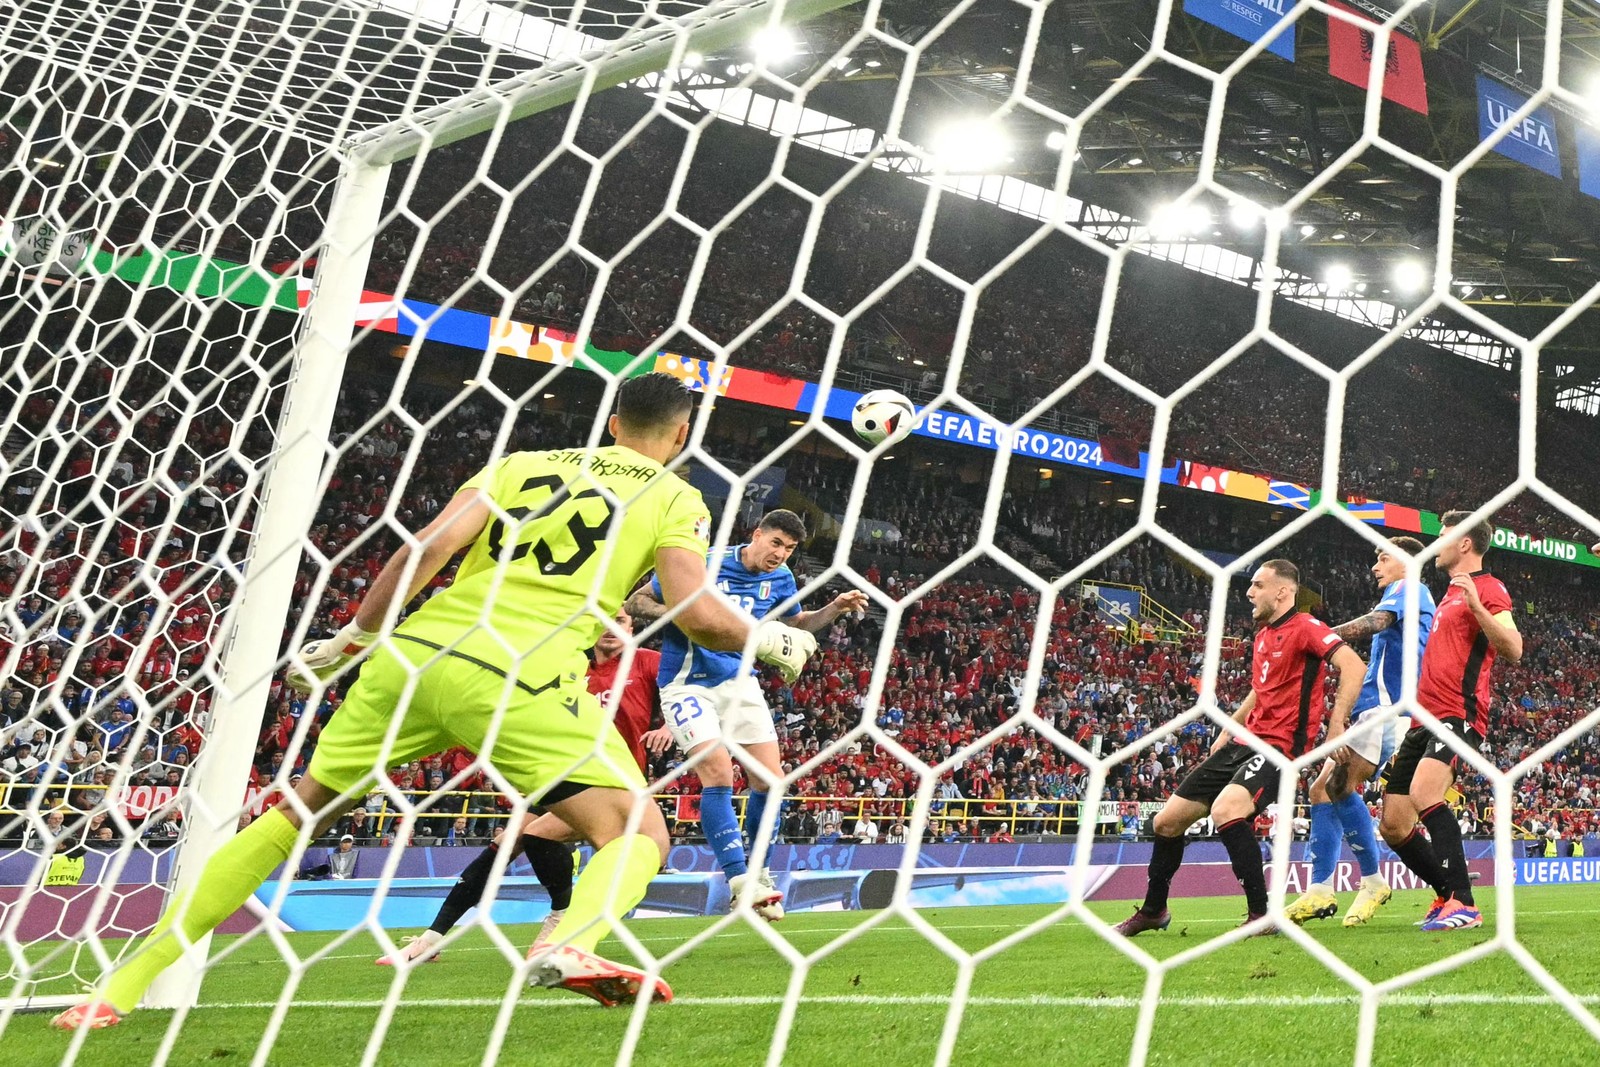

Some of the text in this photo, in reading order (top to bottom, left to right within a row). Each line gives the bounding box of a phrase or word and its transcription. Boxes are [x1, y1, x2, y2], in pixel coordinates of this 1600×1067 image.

[1231, 1, 1262, 23] RESPECT
[745, 483, 774, 499] 27
[488, 474, 617, 576] 23
[1491, 528, 1577, 560] ORTMUND
[1109, 600, 1132, 617] 26
[670, 696, 703, 727] 23
[1262, 862, 1353, 892] ATR
